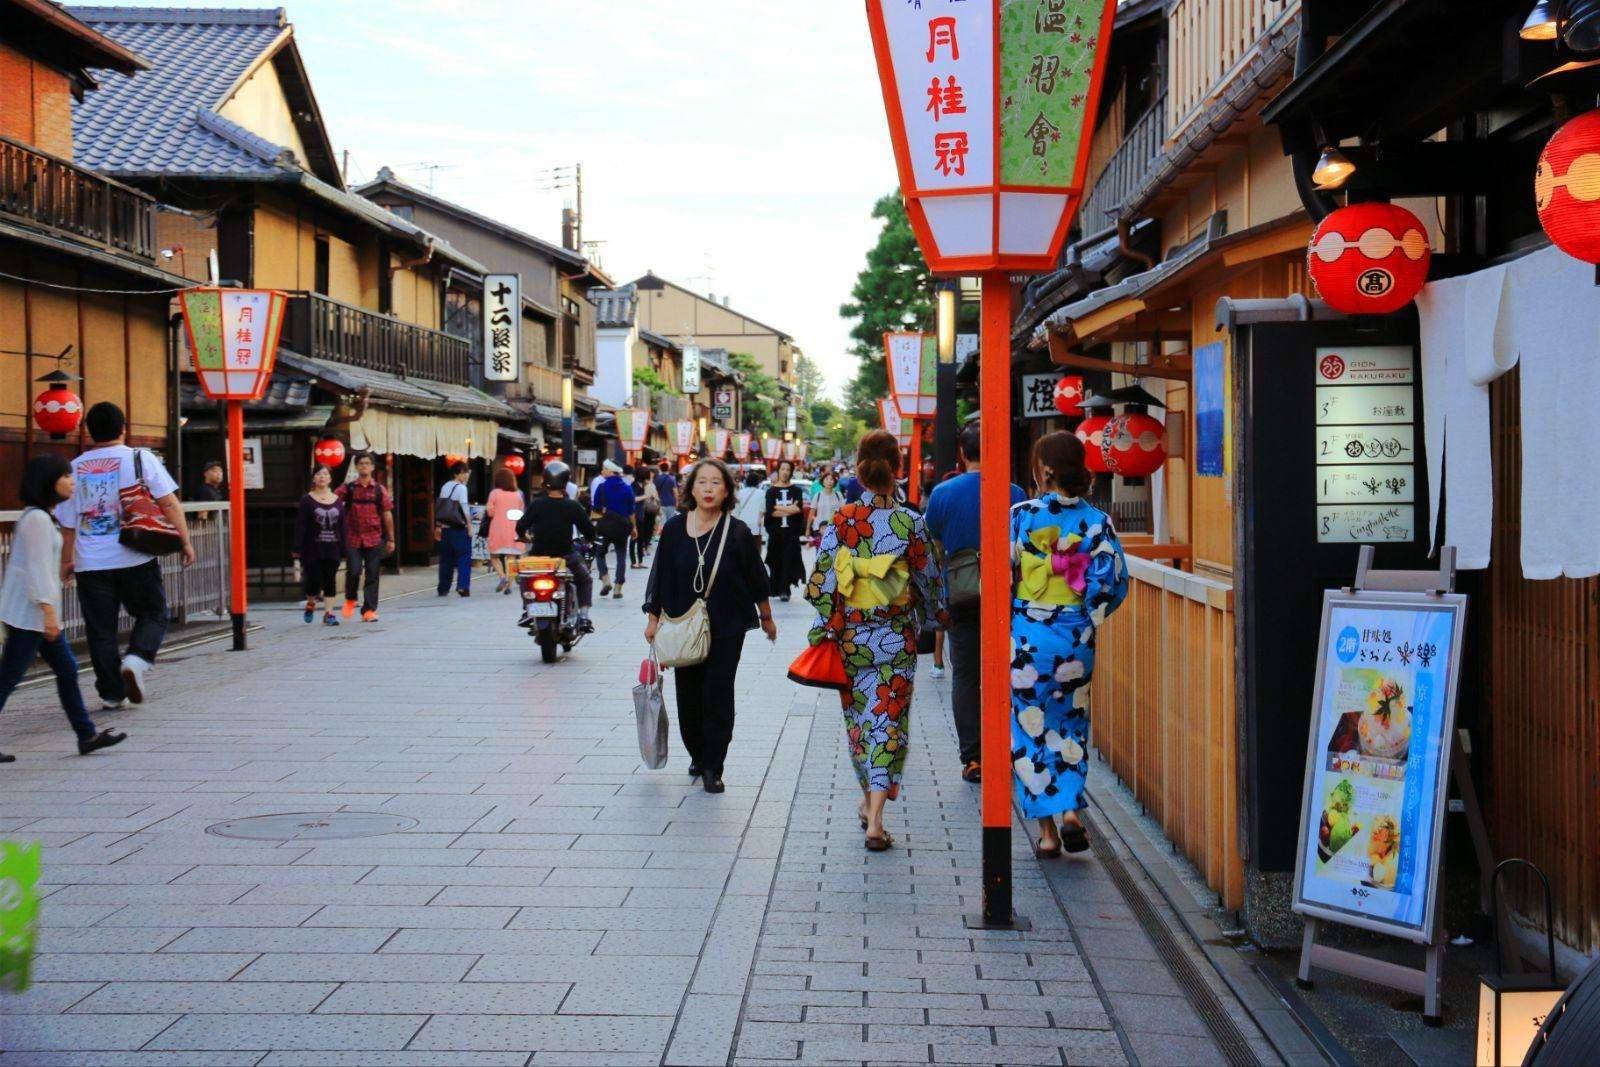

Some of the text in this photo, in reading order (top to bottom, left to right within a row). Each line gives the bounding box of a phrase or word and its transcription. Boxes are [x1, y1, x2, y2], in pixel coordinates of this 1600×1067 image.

[925, 16, 969, 177] 月桂冠
[236, 306, 253, 365] 月桂冠
[490, 281, 512, 374] 十二段家
